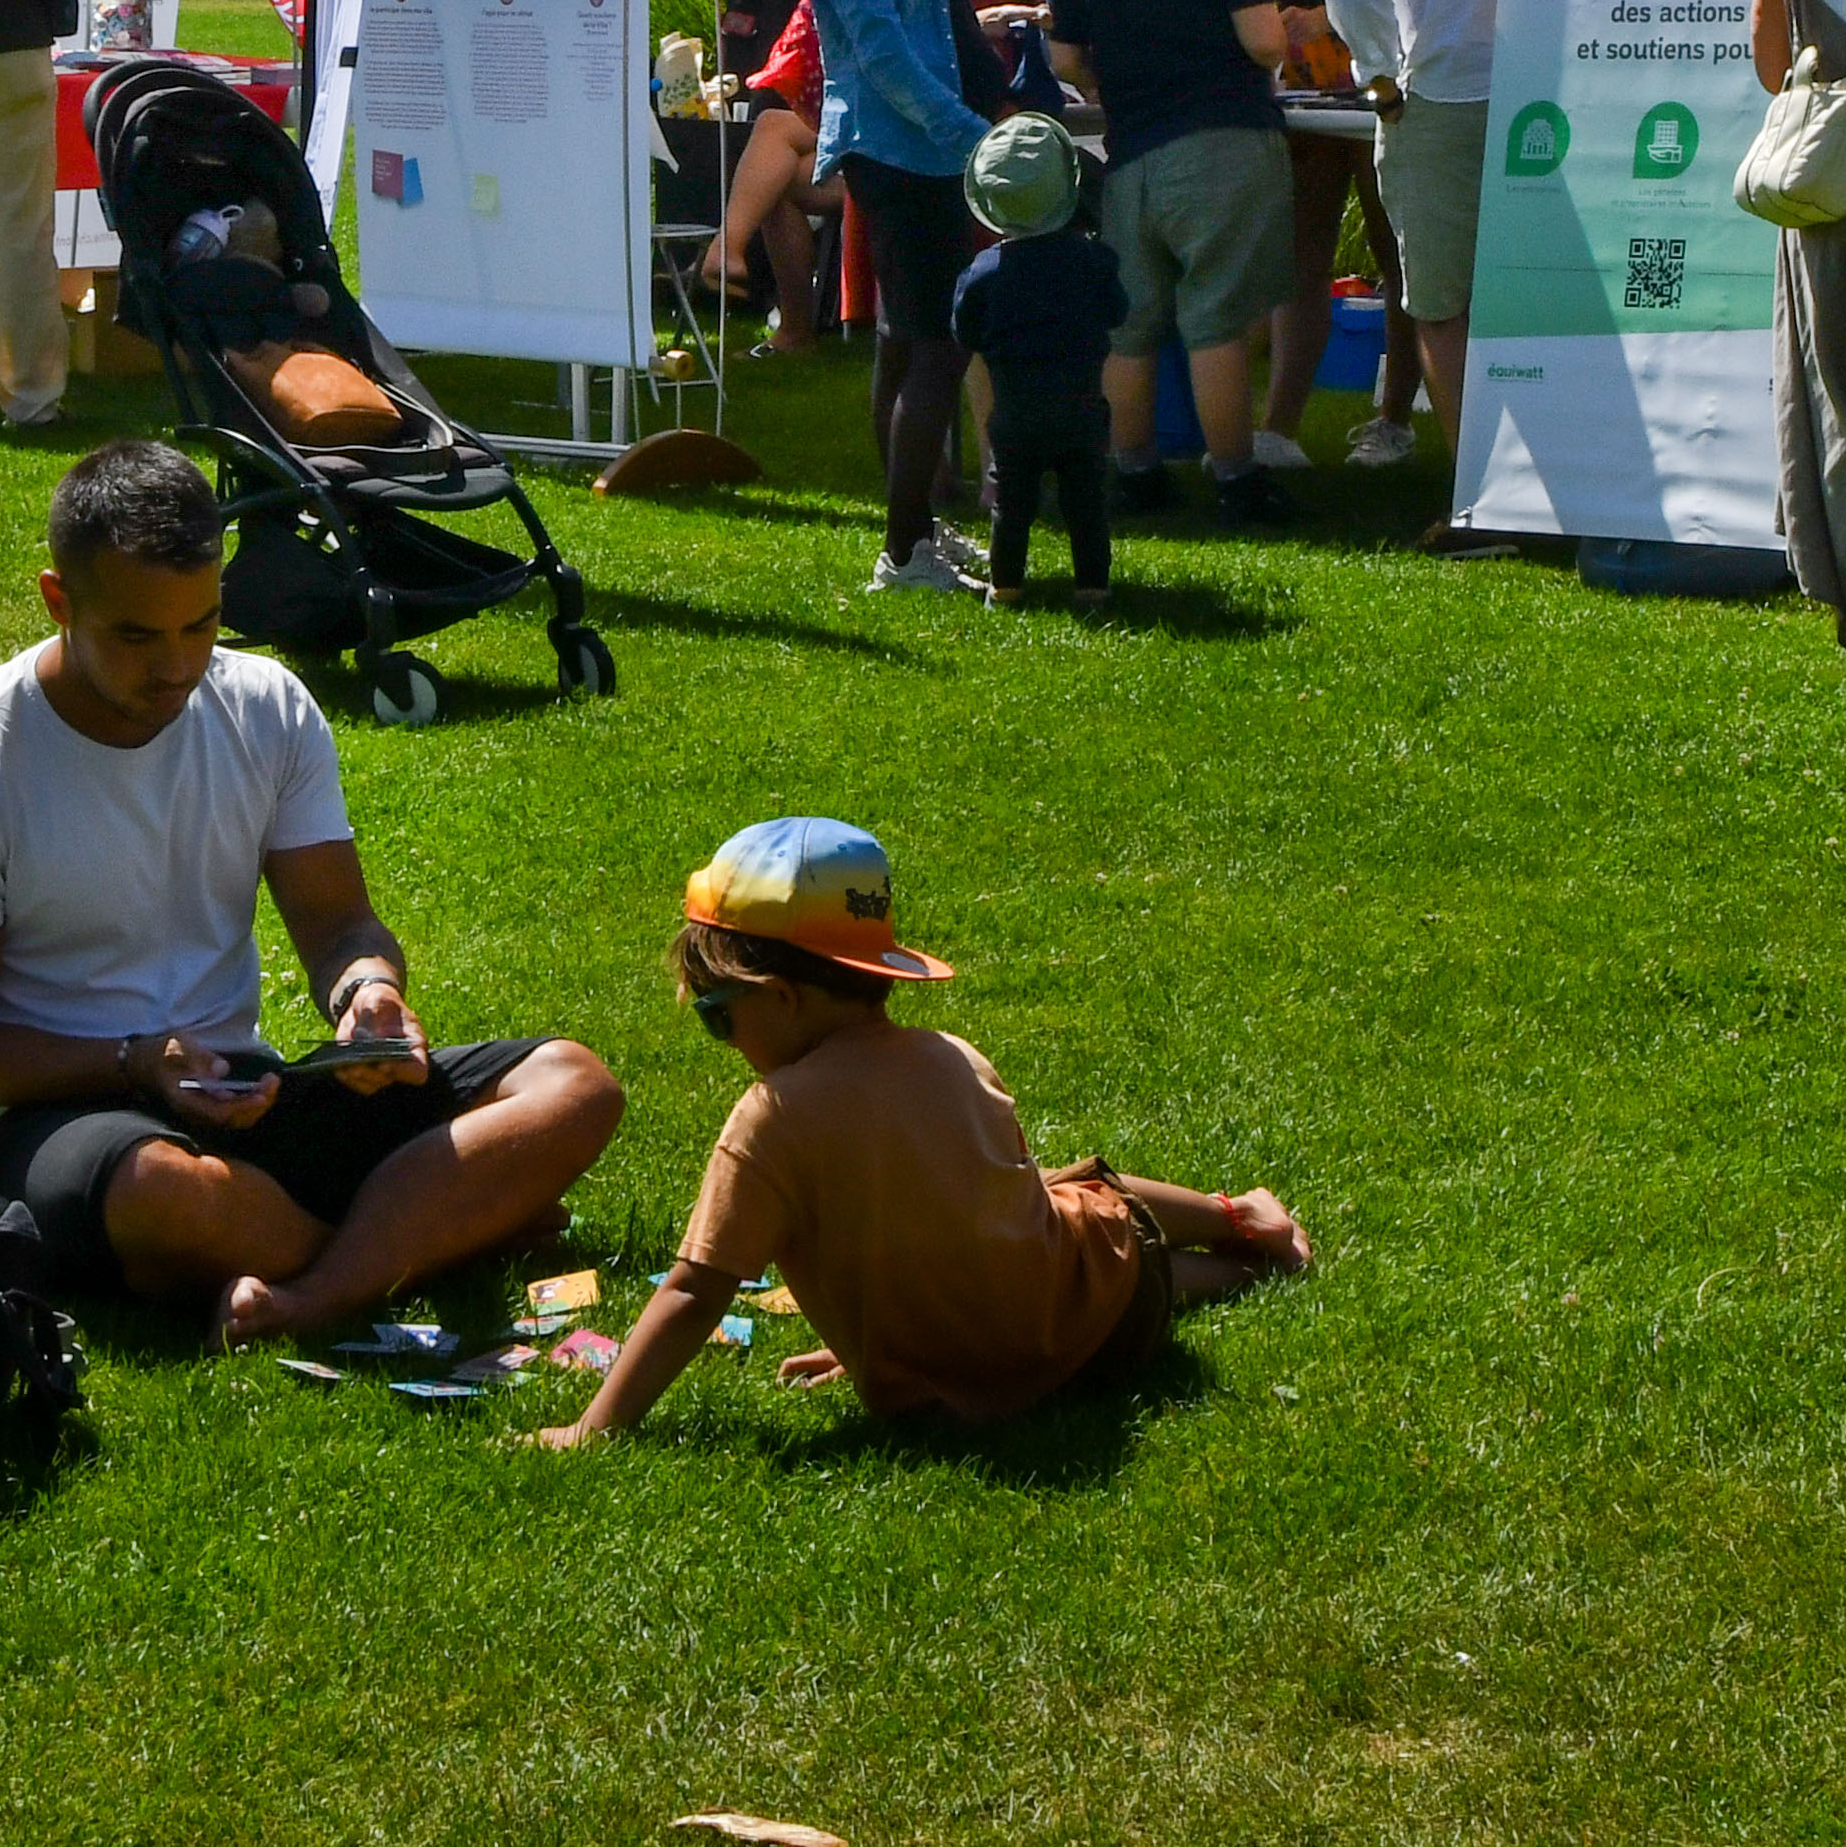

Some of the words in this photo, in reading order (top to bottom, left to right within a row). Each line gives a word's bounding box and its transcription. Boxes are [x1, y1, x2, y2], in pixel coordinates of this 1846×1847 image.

[1611, 1, 1651, 22] des
[1659, 0, 1744, 22] actions
[1577, 39, 1599, 58] et
[1607, 38, 1704, 58] soutiens
